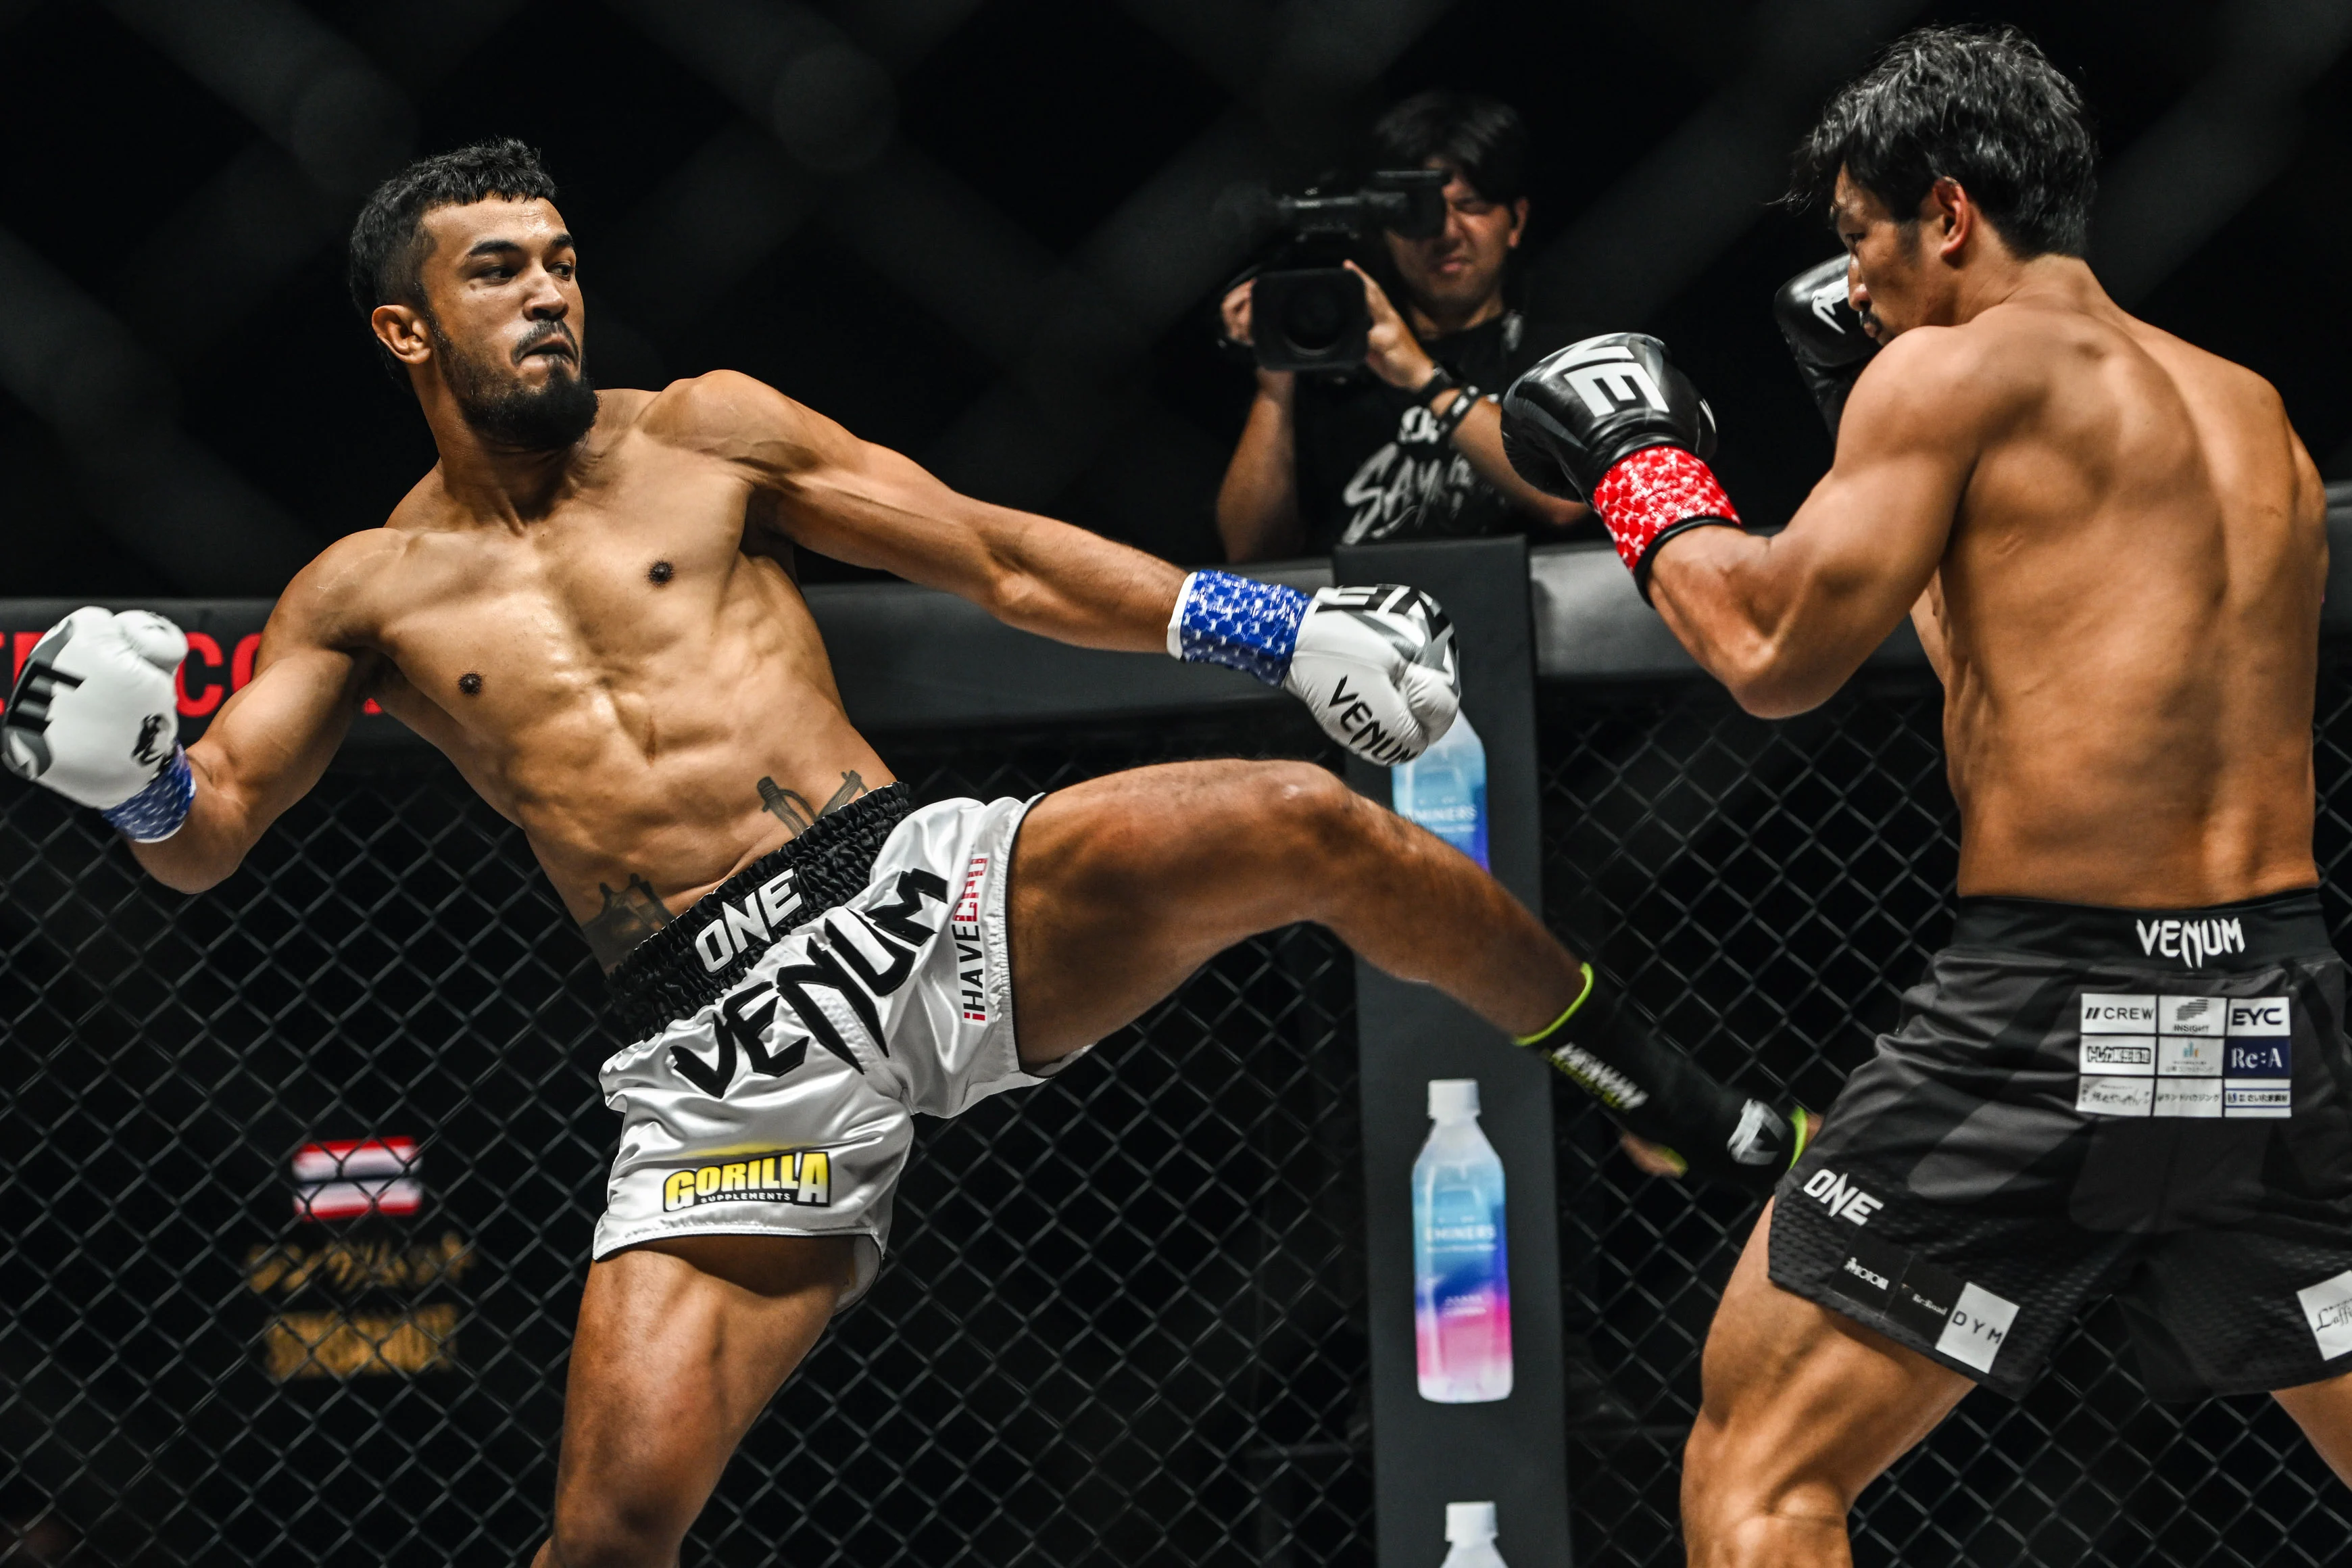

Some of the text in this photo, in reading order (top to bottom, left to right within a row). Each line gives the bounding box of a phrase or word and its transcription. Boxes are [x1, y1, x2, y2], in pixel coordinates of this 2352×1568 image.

[1328, 675, 1418, 765] VENUM
[695, 868, 803, 973] ONE
[2136, 917, 2246, 969] VENUM
[670, 868, 949, 1099] VENUM
[2232, 1008, 2283, 1025] EYC
[2232, 1047, 2282, 1069] Re:A
[664, 1152, 830, 1212] GORILLA
[701, 1192, 791, 1204] SUPPLEMENTS
[1803, 1169, 1884, 1225] ONE
[1952, 1310, 2003, 1344] DYM
